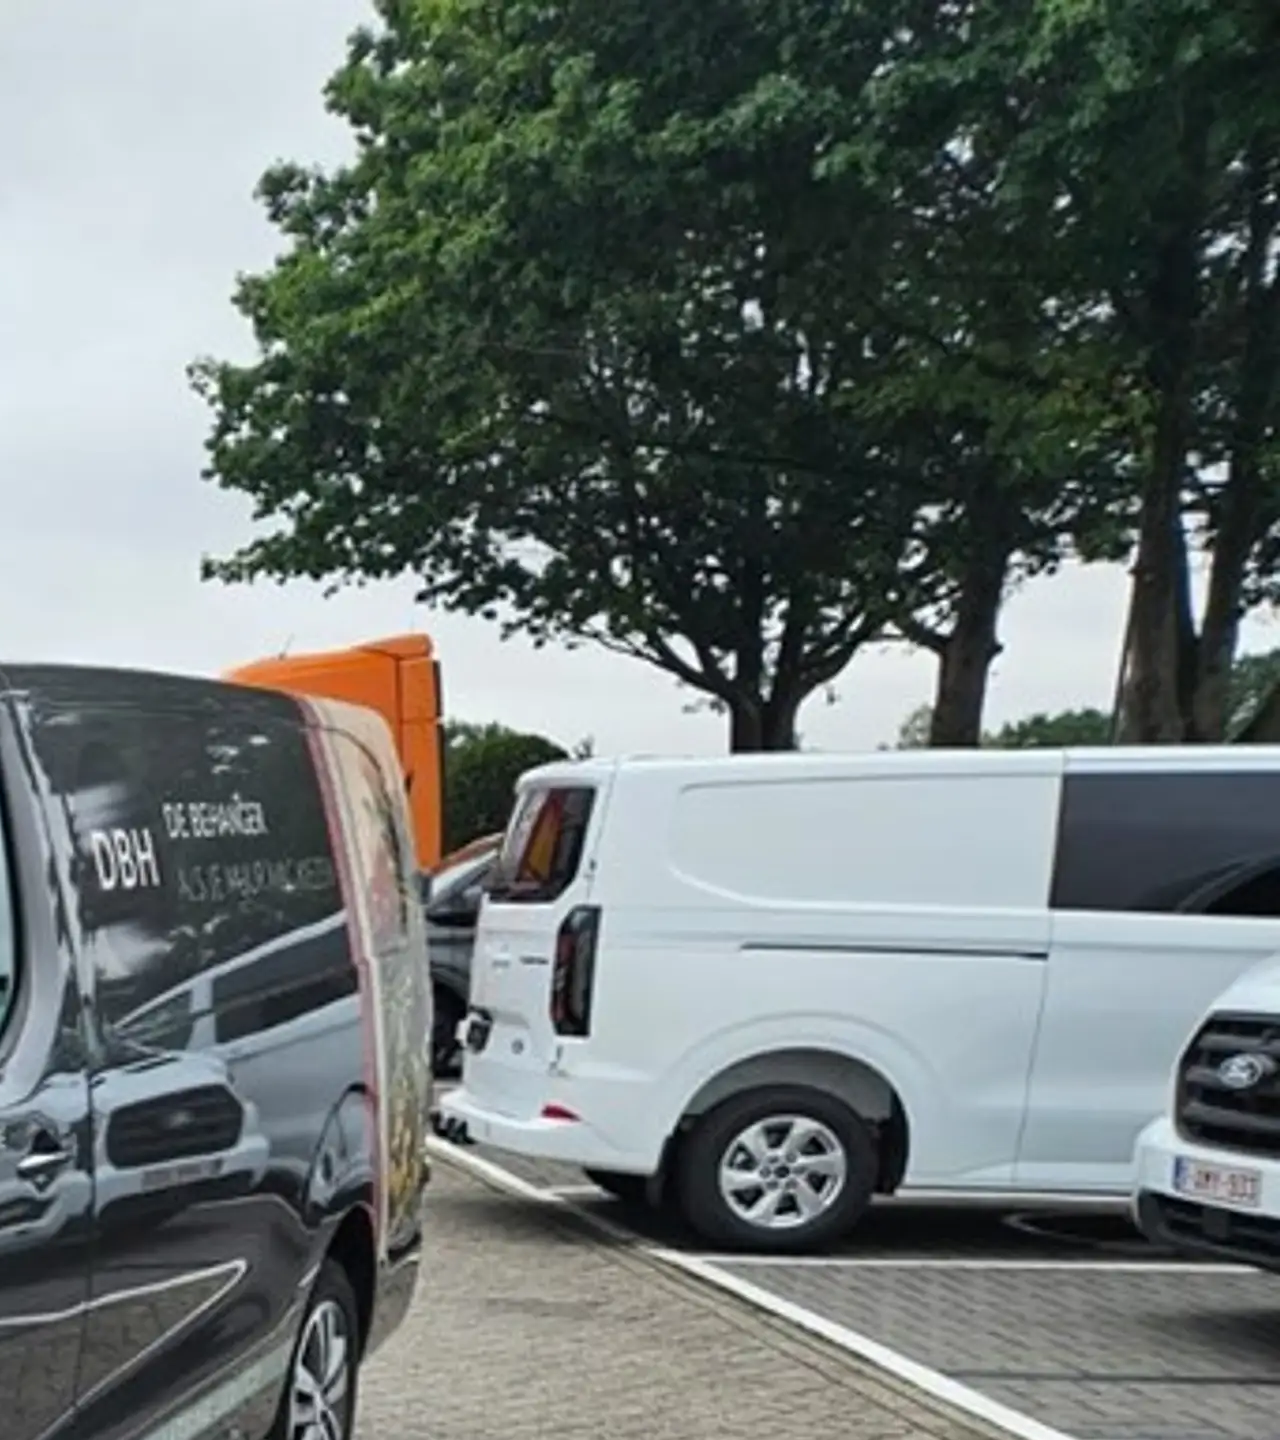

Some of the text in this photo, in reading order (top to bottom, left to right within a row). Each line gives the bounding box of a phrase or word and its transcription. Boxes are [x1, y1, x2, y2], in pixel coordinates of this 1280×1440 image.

[162, 800, 268, 839] DE BEHANGER
[90, 827, 161, 892] DBH
